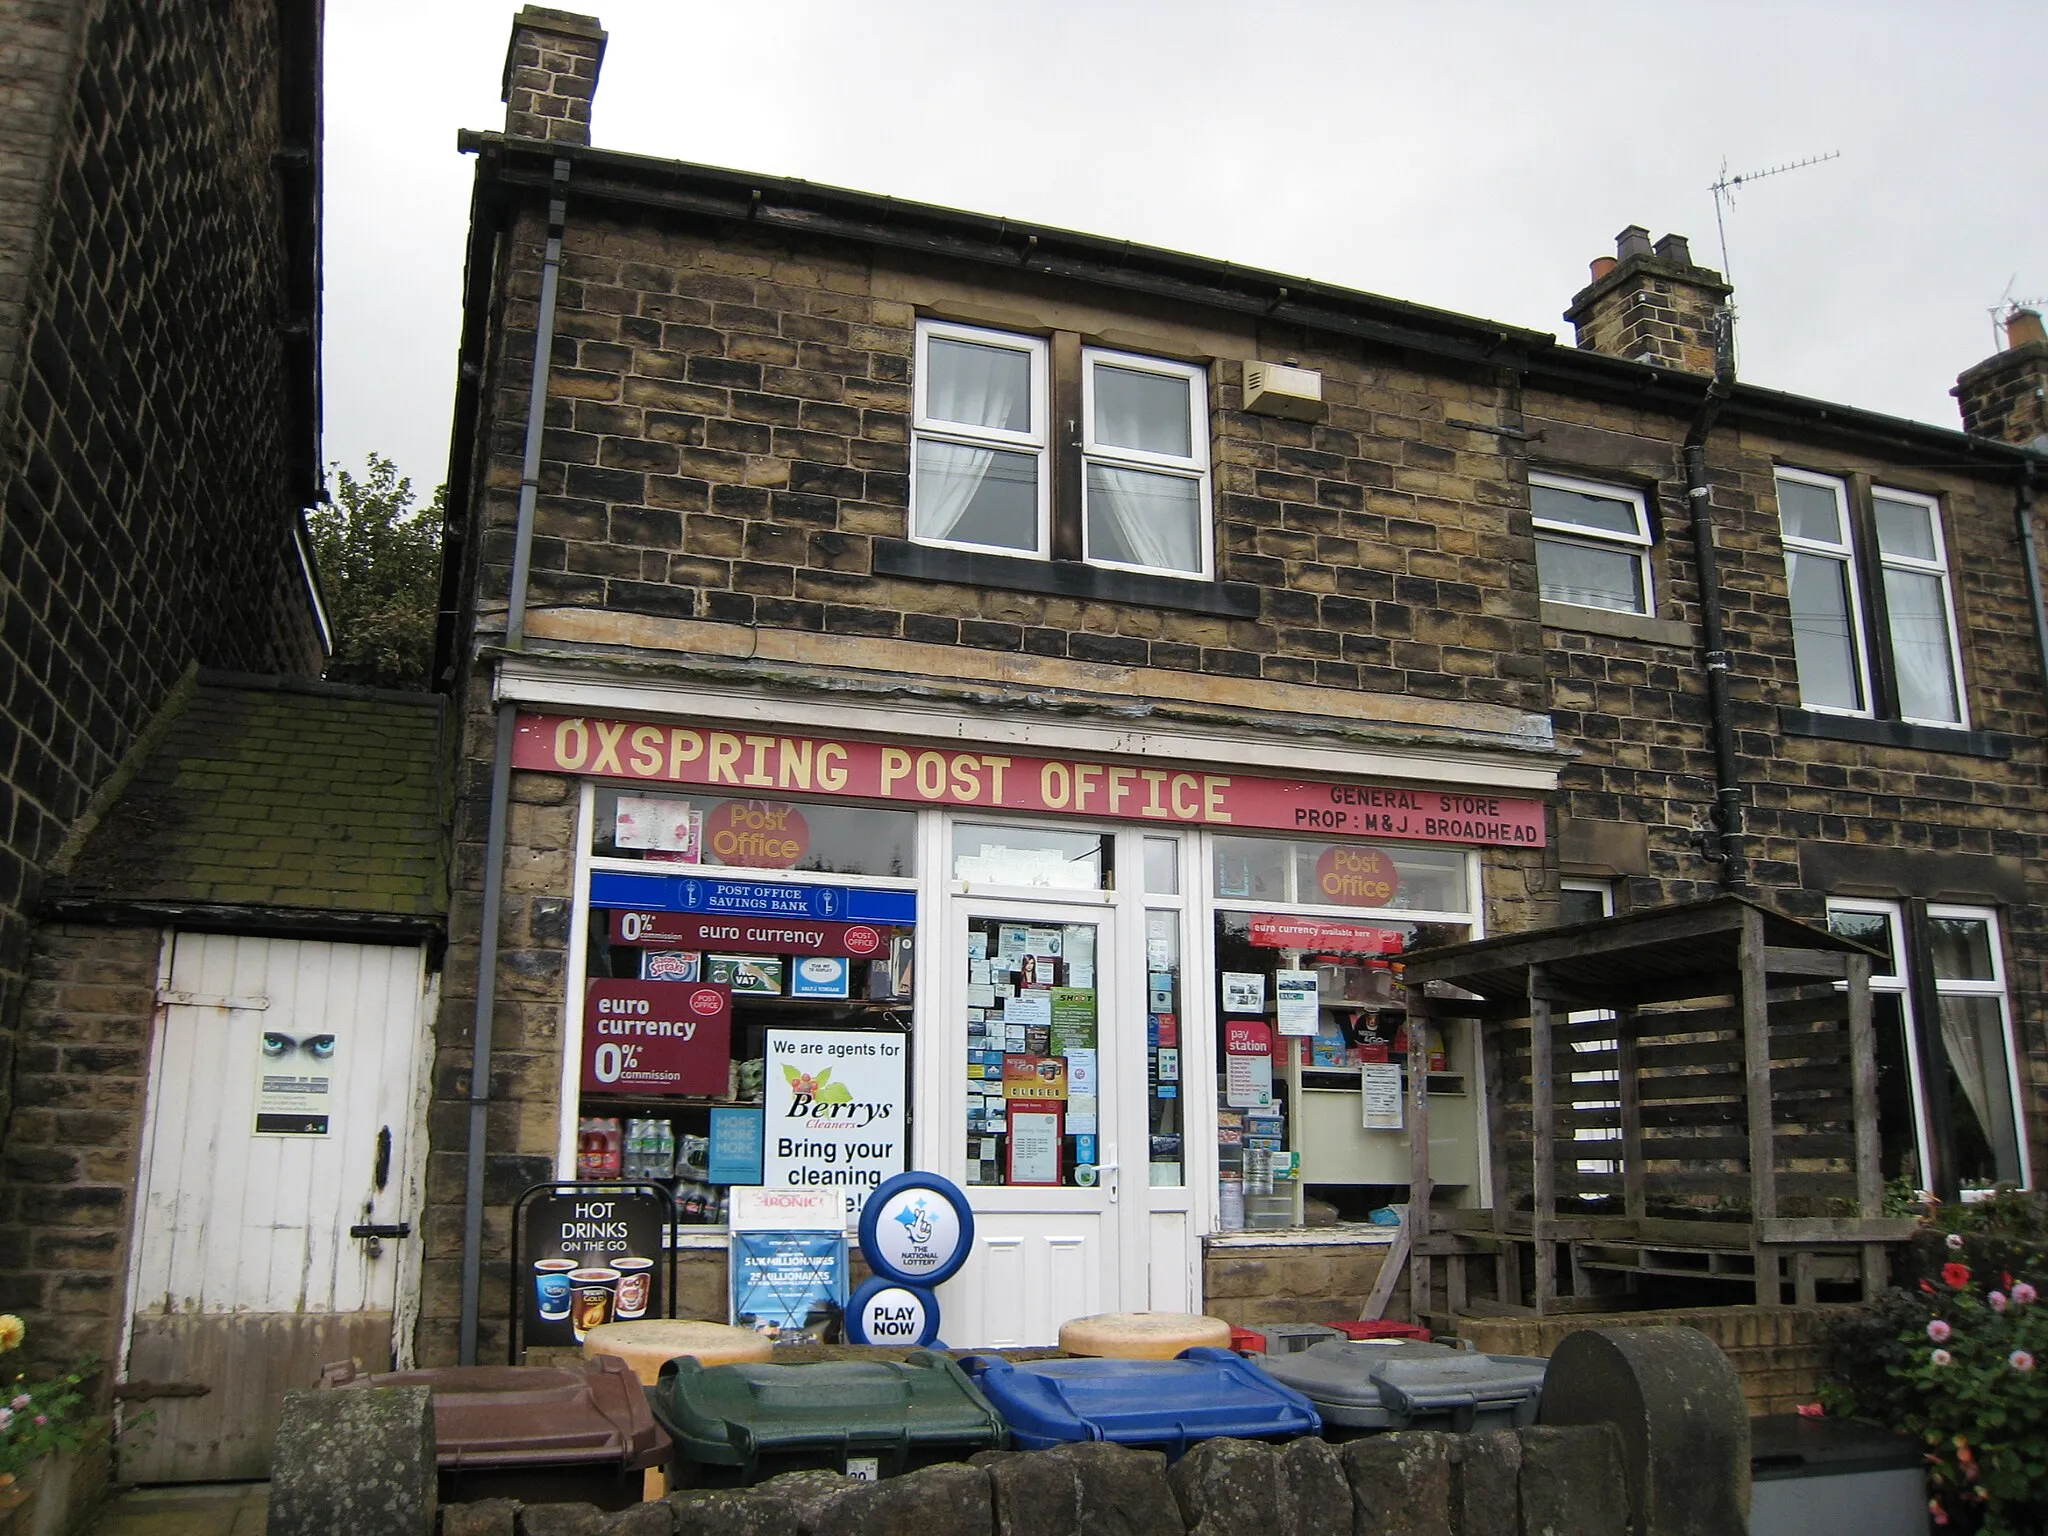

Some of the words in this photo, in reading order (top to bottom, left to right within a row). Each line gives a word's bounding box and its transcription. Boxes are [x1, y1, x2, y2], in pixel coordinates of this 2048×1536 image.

[554, 719, 848, 791] OXSPRING
[881, 747, 1011, 804] POST
[1040, 762, 1232, 822] OFFICE
[1331, 786, 1423, 810] GENERAL
[1440, 797, 1500, 816] STORE
[731, 804, 787, 831] Post
[1425, 818, 1537, 842] BROADHEAD
[713, 830, 799, 858] Office
[1334, 849, 1380, 873] Post
[717, 885, 750, 896] POST
[754, 887, 802, 899] OFFICE
[1322, 872, 1391, 898] Office
[709, 896, 767, 909] SAVINGS
[771, 900, 808, 911] BANK
[699, 925, 740, 940] euro
[746, 927, 824, 948] currency
[852, 931, 872, 939] POST
[1254, 923, 1276, 933] euro
[1278, 924, 1319, 936] currency
[1321, 928, 1353, 936] available
[847, 938, 875, 947] OFFICE
[650, 960, 685, 975] Streaks
[653, 956, 677, 965] Bacon
[736, 976, 756, 985] VAT
[598, 998, 650, 1015] euro
[693, 1001, 719, 1010] OFFICE
[597, 1018, 697, 1041] currency
[1231, 1030, 1249, 1041] pay
[773, 1040, 796, 1054] We
[800, 1043, 823, 1054] are
[828, 1042, 876, 1058] agents
[880, 1043, 900, 1057] for
[1229, 1040, 1267, 1052] station
[620, 1069, 681, 1081] commission
[1011, 1088, 1060, 1096] CLOSED
[785, 1092, 893, 1128] Berrys
[806, 1119, 856, 1129] Cleaners
[778, 1138, 836, 1163] Bring
[845, 1142, 893, 1163] your
[788, 1166, 881, 1188] cleaning
[575, 1202, 615, 1219] HOT
[561, 1222, 628, 1239] DRINKS
[561, 1242, 581, 1252] ON
[583, 1241, 604, 1251] THE
[607, 1240, 627, 1251] GO
[744, 1257, 751, 1266] 5
[767, 1256, 835, 1266] MILLIONAIRES
[874, 1307, 916, 1321] PLAY
[874, 1322, 916, 1336] NOW
